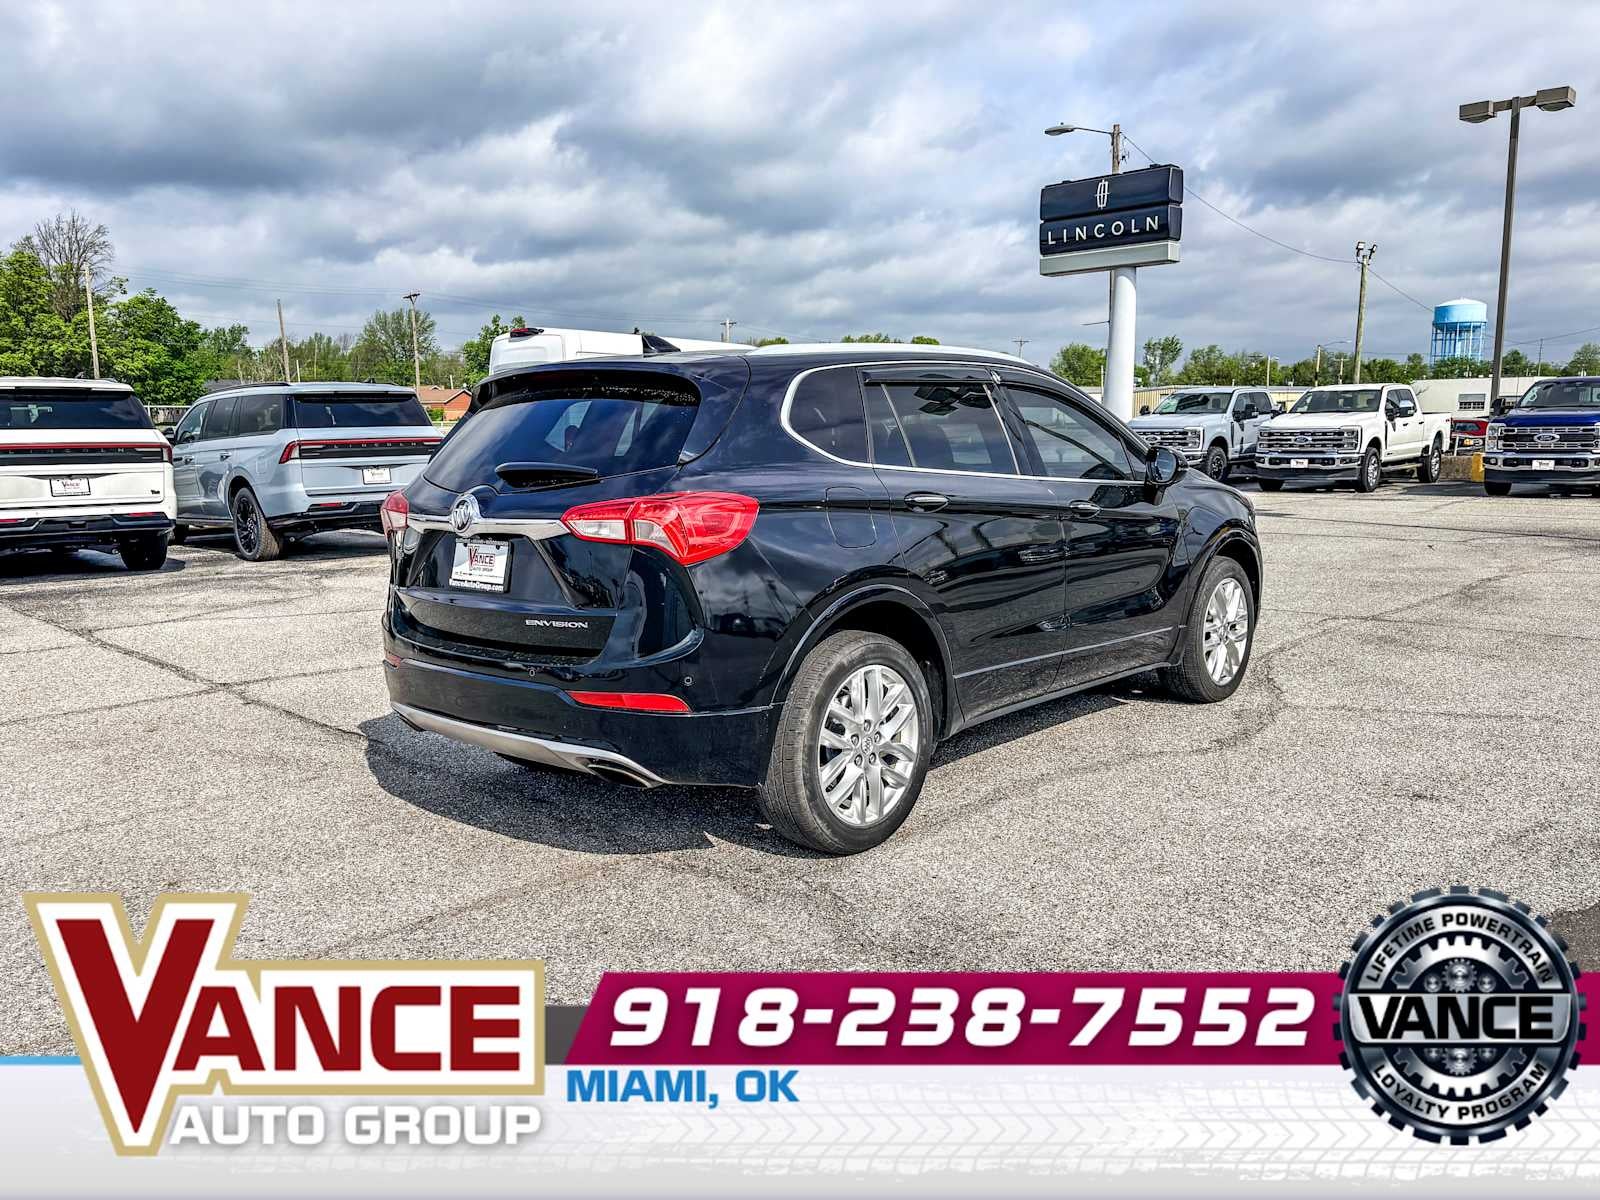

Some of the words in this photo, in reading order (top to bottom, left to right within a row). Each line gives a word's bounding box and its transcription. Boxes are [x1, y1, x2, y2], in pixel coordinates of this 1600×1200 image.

[1048, 215, 1159, 245] LINCOLN
[469, 547, 494, 568] VANCE
[525, 619, 589, 629] ENVISION
